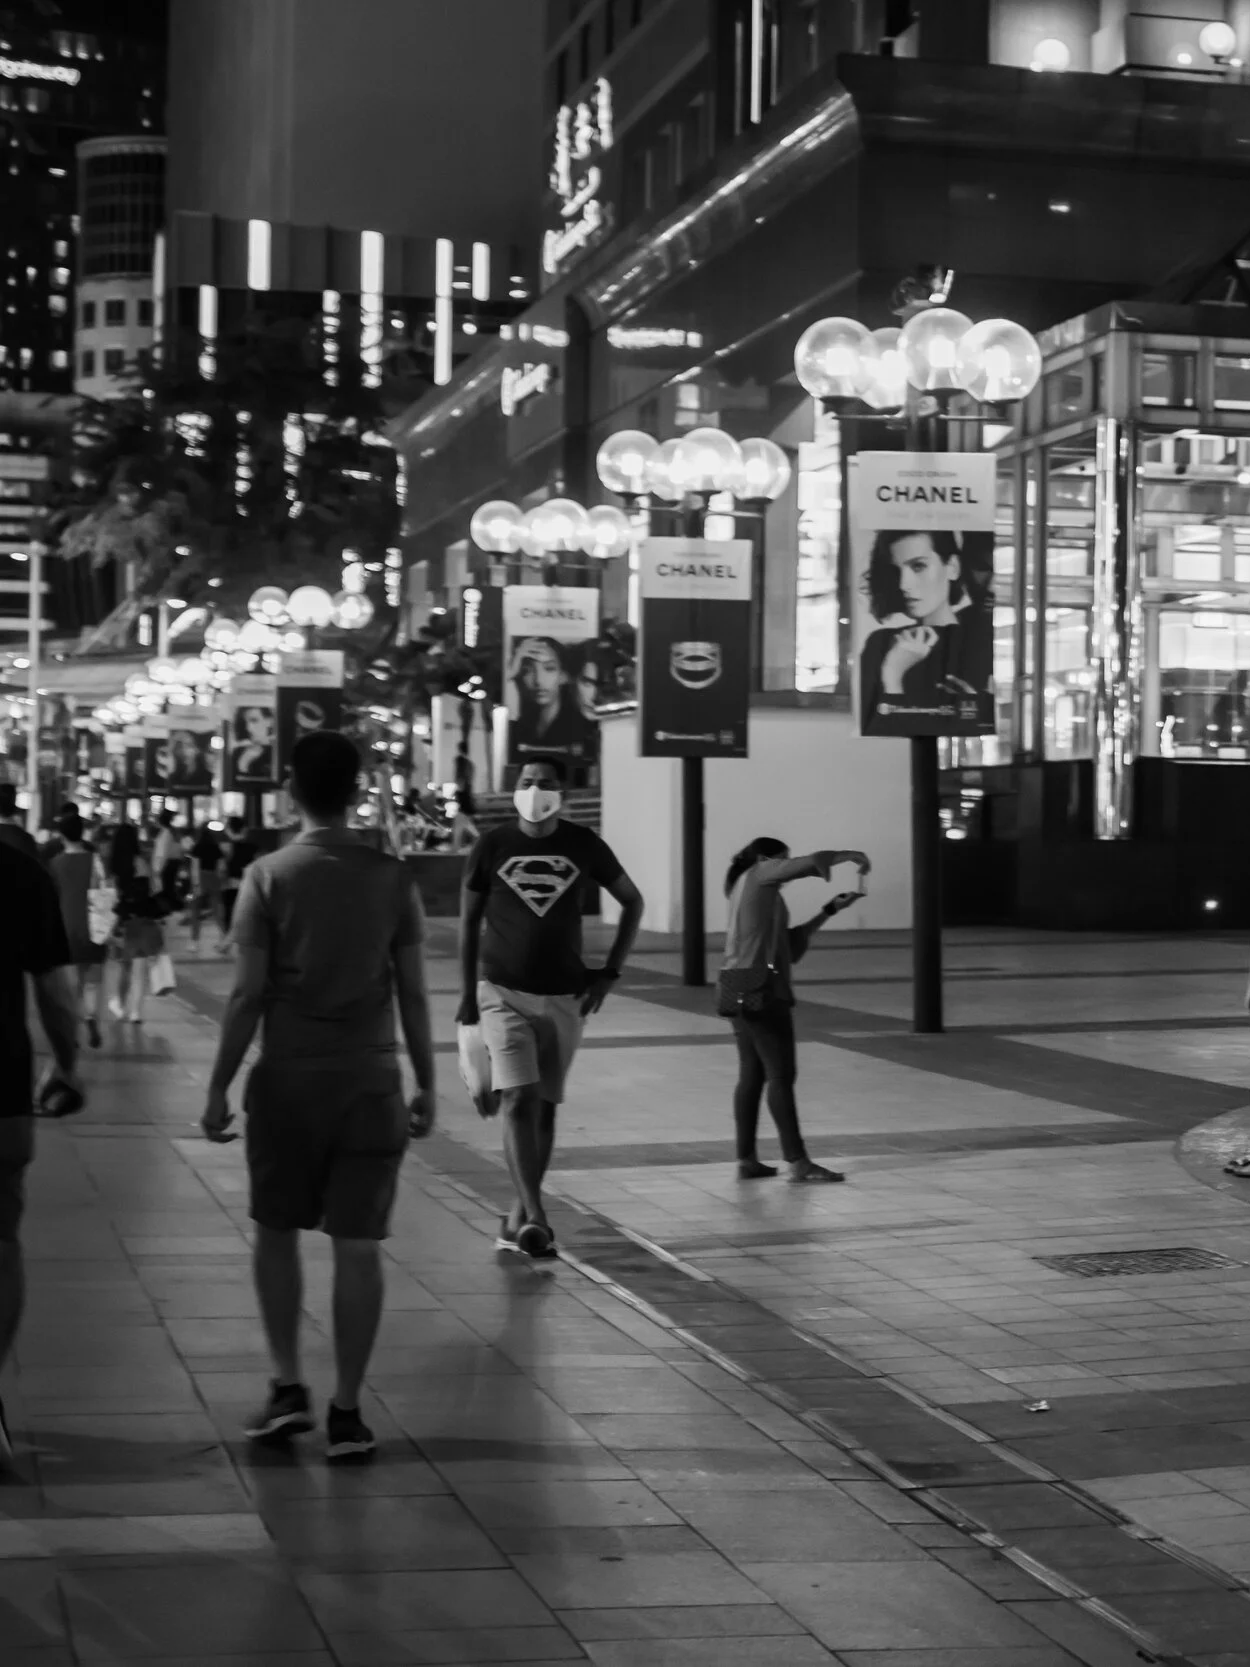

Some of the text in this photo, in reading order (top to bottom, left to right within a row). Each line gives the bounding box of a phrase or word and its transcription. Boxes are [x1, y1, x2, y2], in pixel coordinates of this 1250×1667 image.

[876, 485, 979, 504] CHANEL
[656, 563, 738, 579] CHANEL
[519, 607, 587, 621] CHANEL
